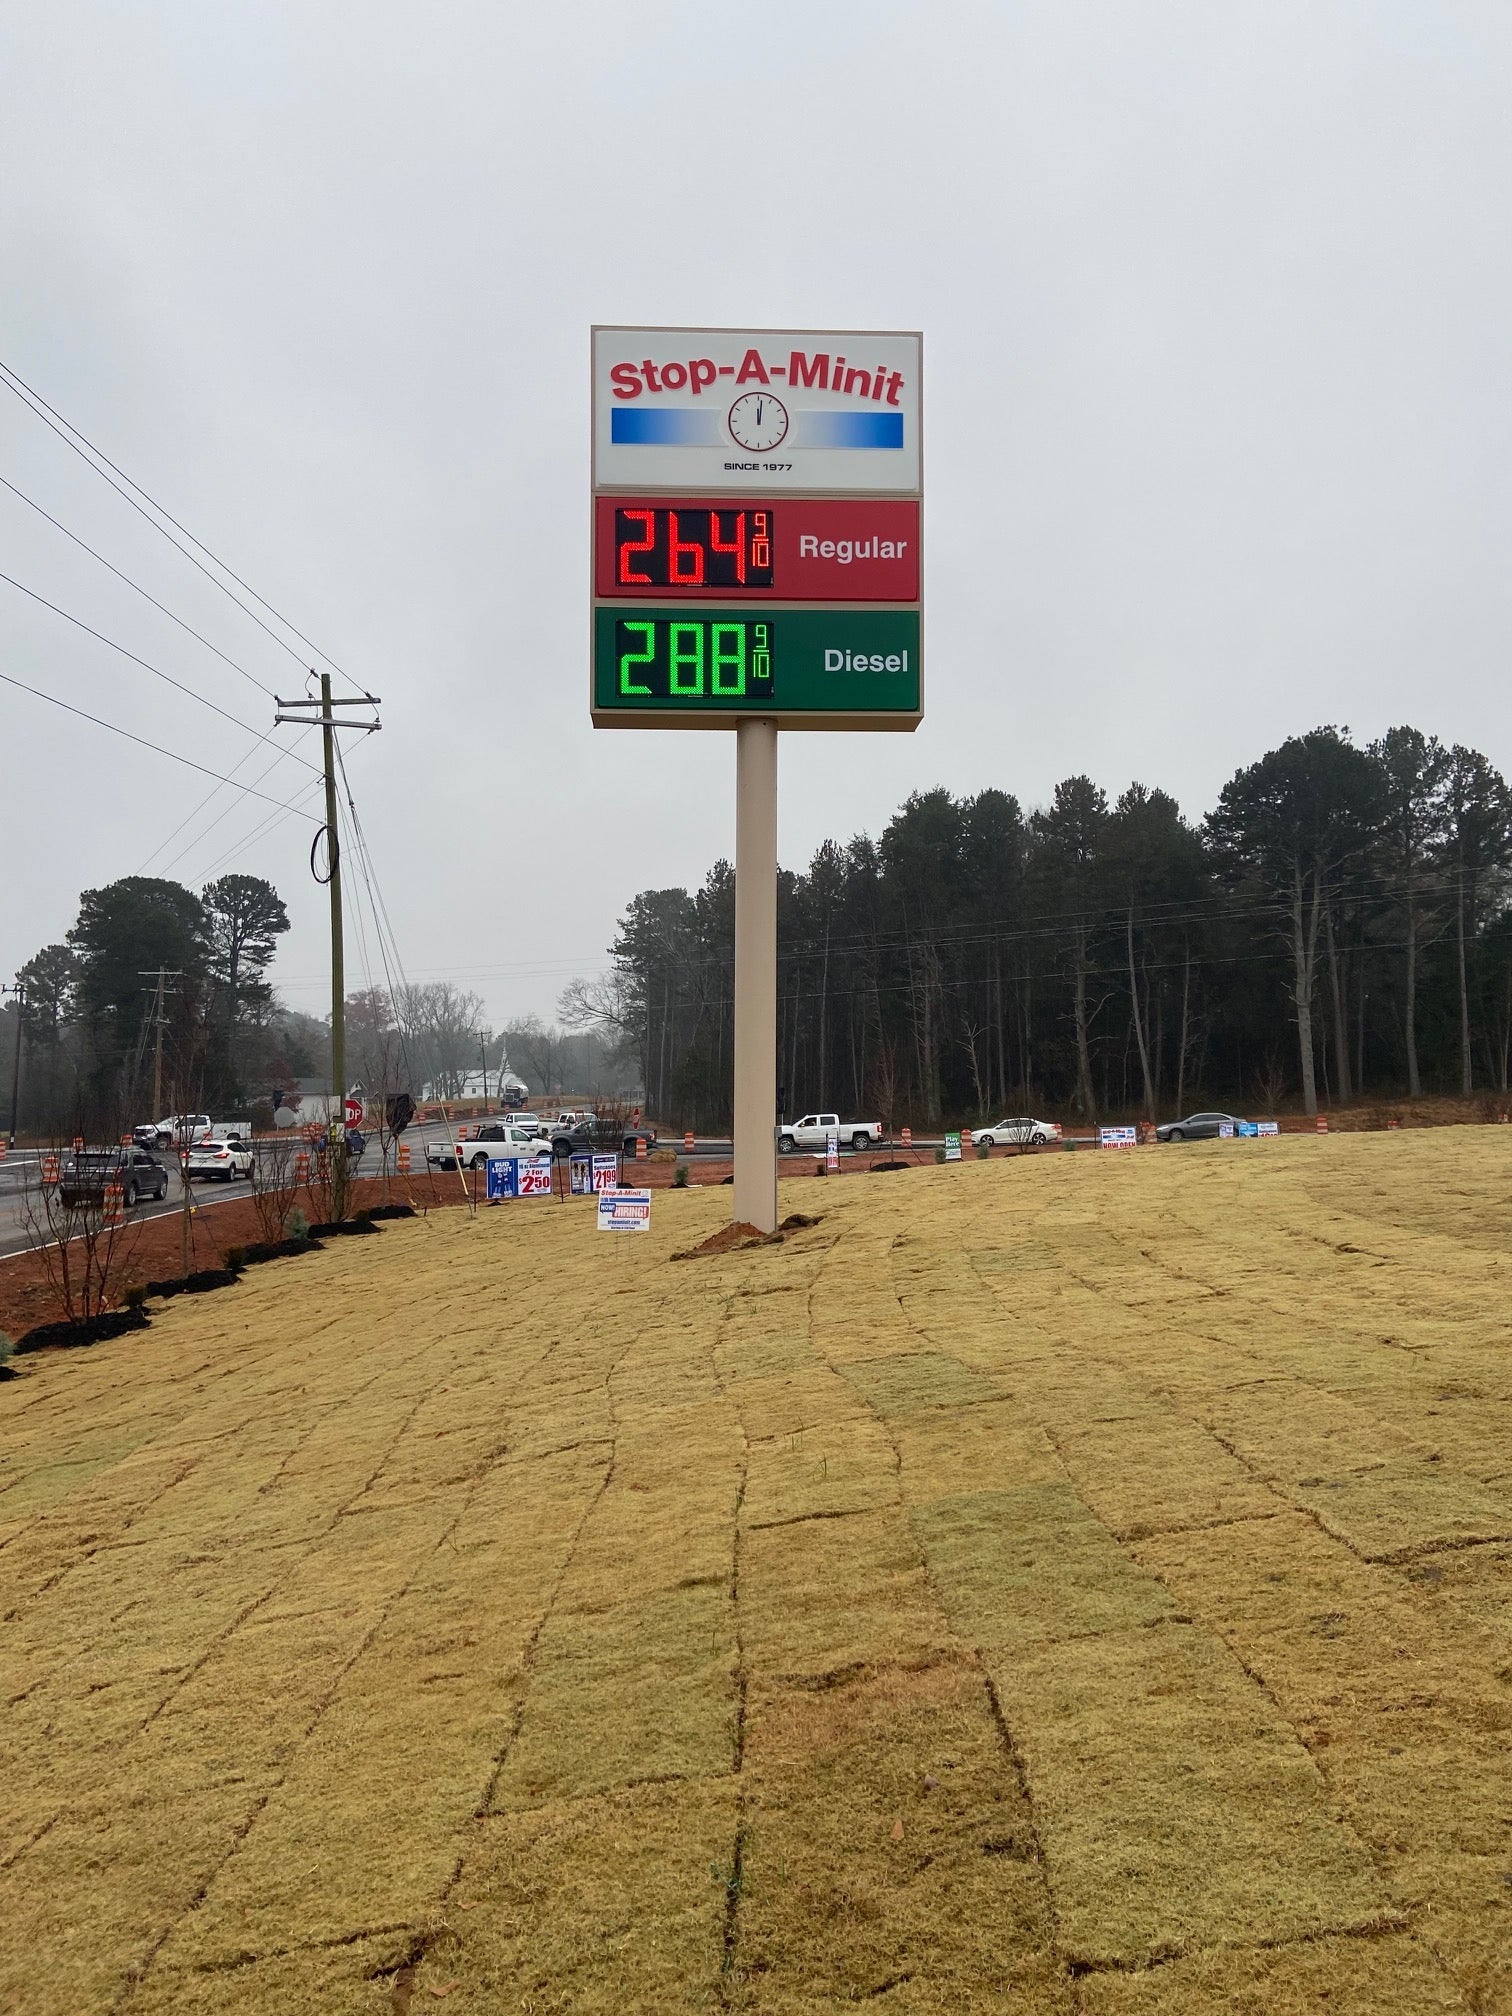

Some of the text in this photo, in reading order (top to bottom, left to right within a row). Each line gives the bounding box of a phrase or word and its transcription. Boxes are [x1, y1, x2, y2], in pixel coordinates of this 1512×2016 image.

[611, 349, 904, 406] Stop-A-Minit
[724, 463, 793, 471] SINCE 1977
[620, 511, 745, 583] 264
[800, 536, 907, 564] Regular
[620, 622, 746, 694] 288
[825, 649, 908, 673] Diesel
[615, 1206, 647, 1217] HIRING!
